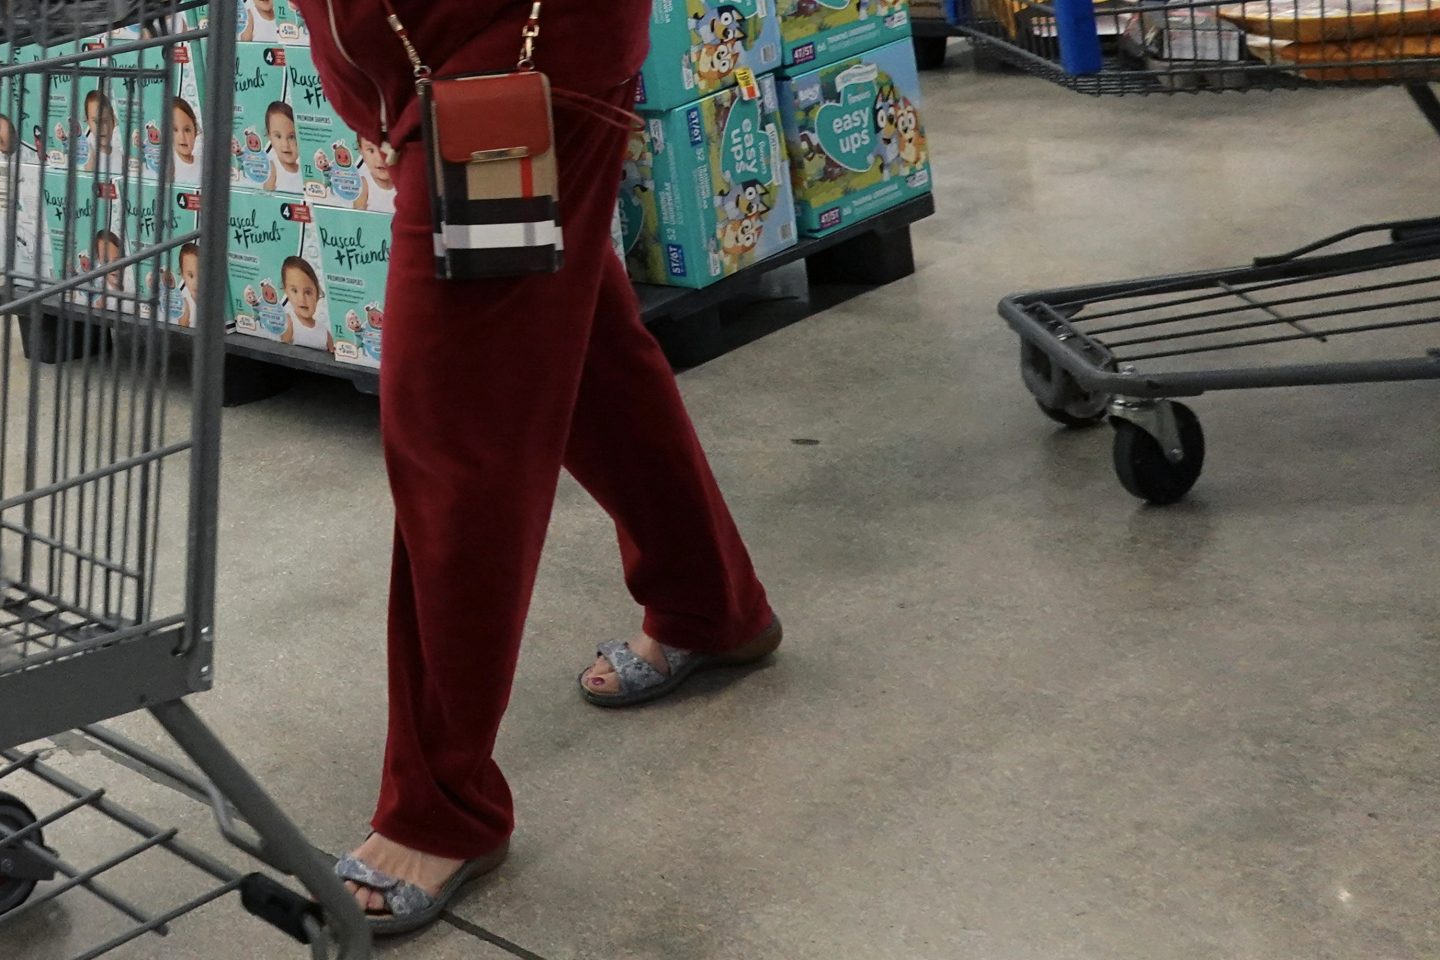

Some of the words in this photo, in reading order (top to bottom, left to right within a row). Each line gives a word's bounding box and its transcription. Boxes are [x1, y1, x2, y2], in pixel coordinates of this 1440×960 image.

[266, 52, 273, 63] 4
[297, 114, 313, 123] PREMIUM
[832, 107, 870, 134] easy
[729, 128, 747, 174] ups
[741, 118, 758, 174] easy
[839, 130, 871, 155] ups
[179, 196, 185, 206] 4
[283, 207, 290, 218] 4
[228, 209, 259, 228] ascal
[234, 221, 281, 249] +Friends
[320, 226, 364, 248] Rascal
[668, 244, 682, 274] 5T/6T
